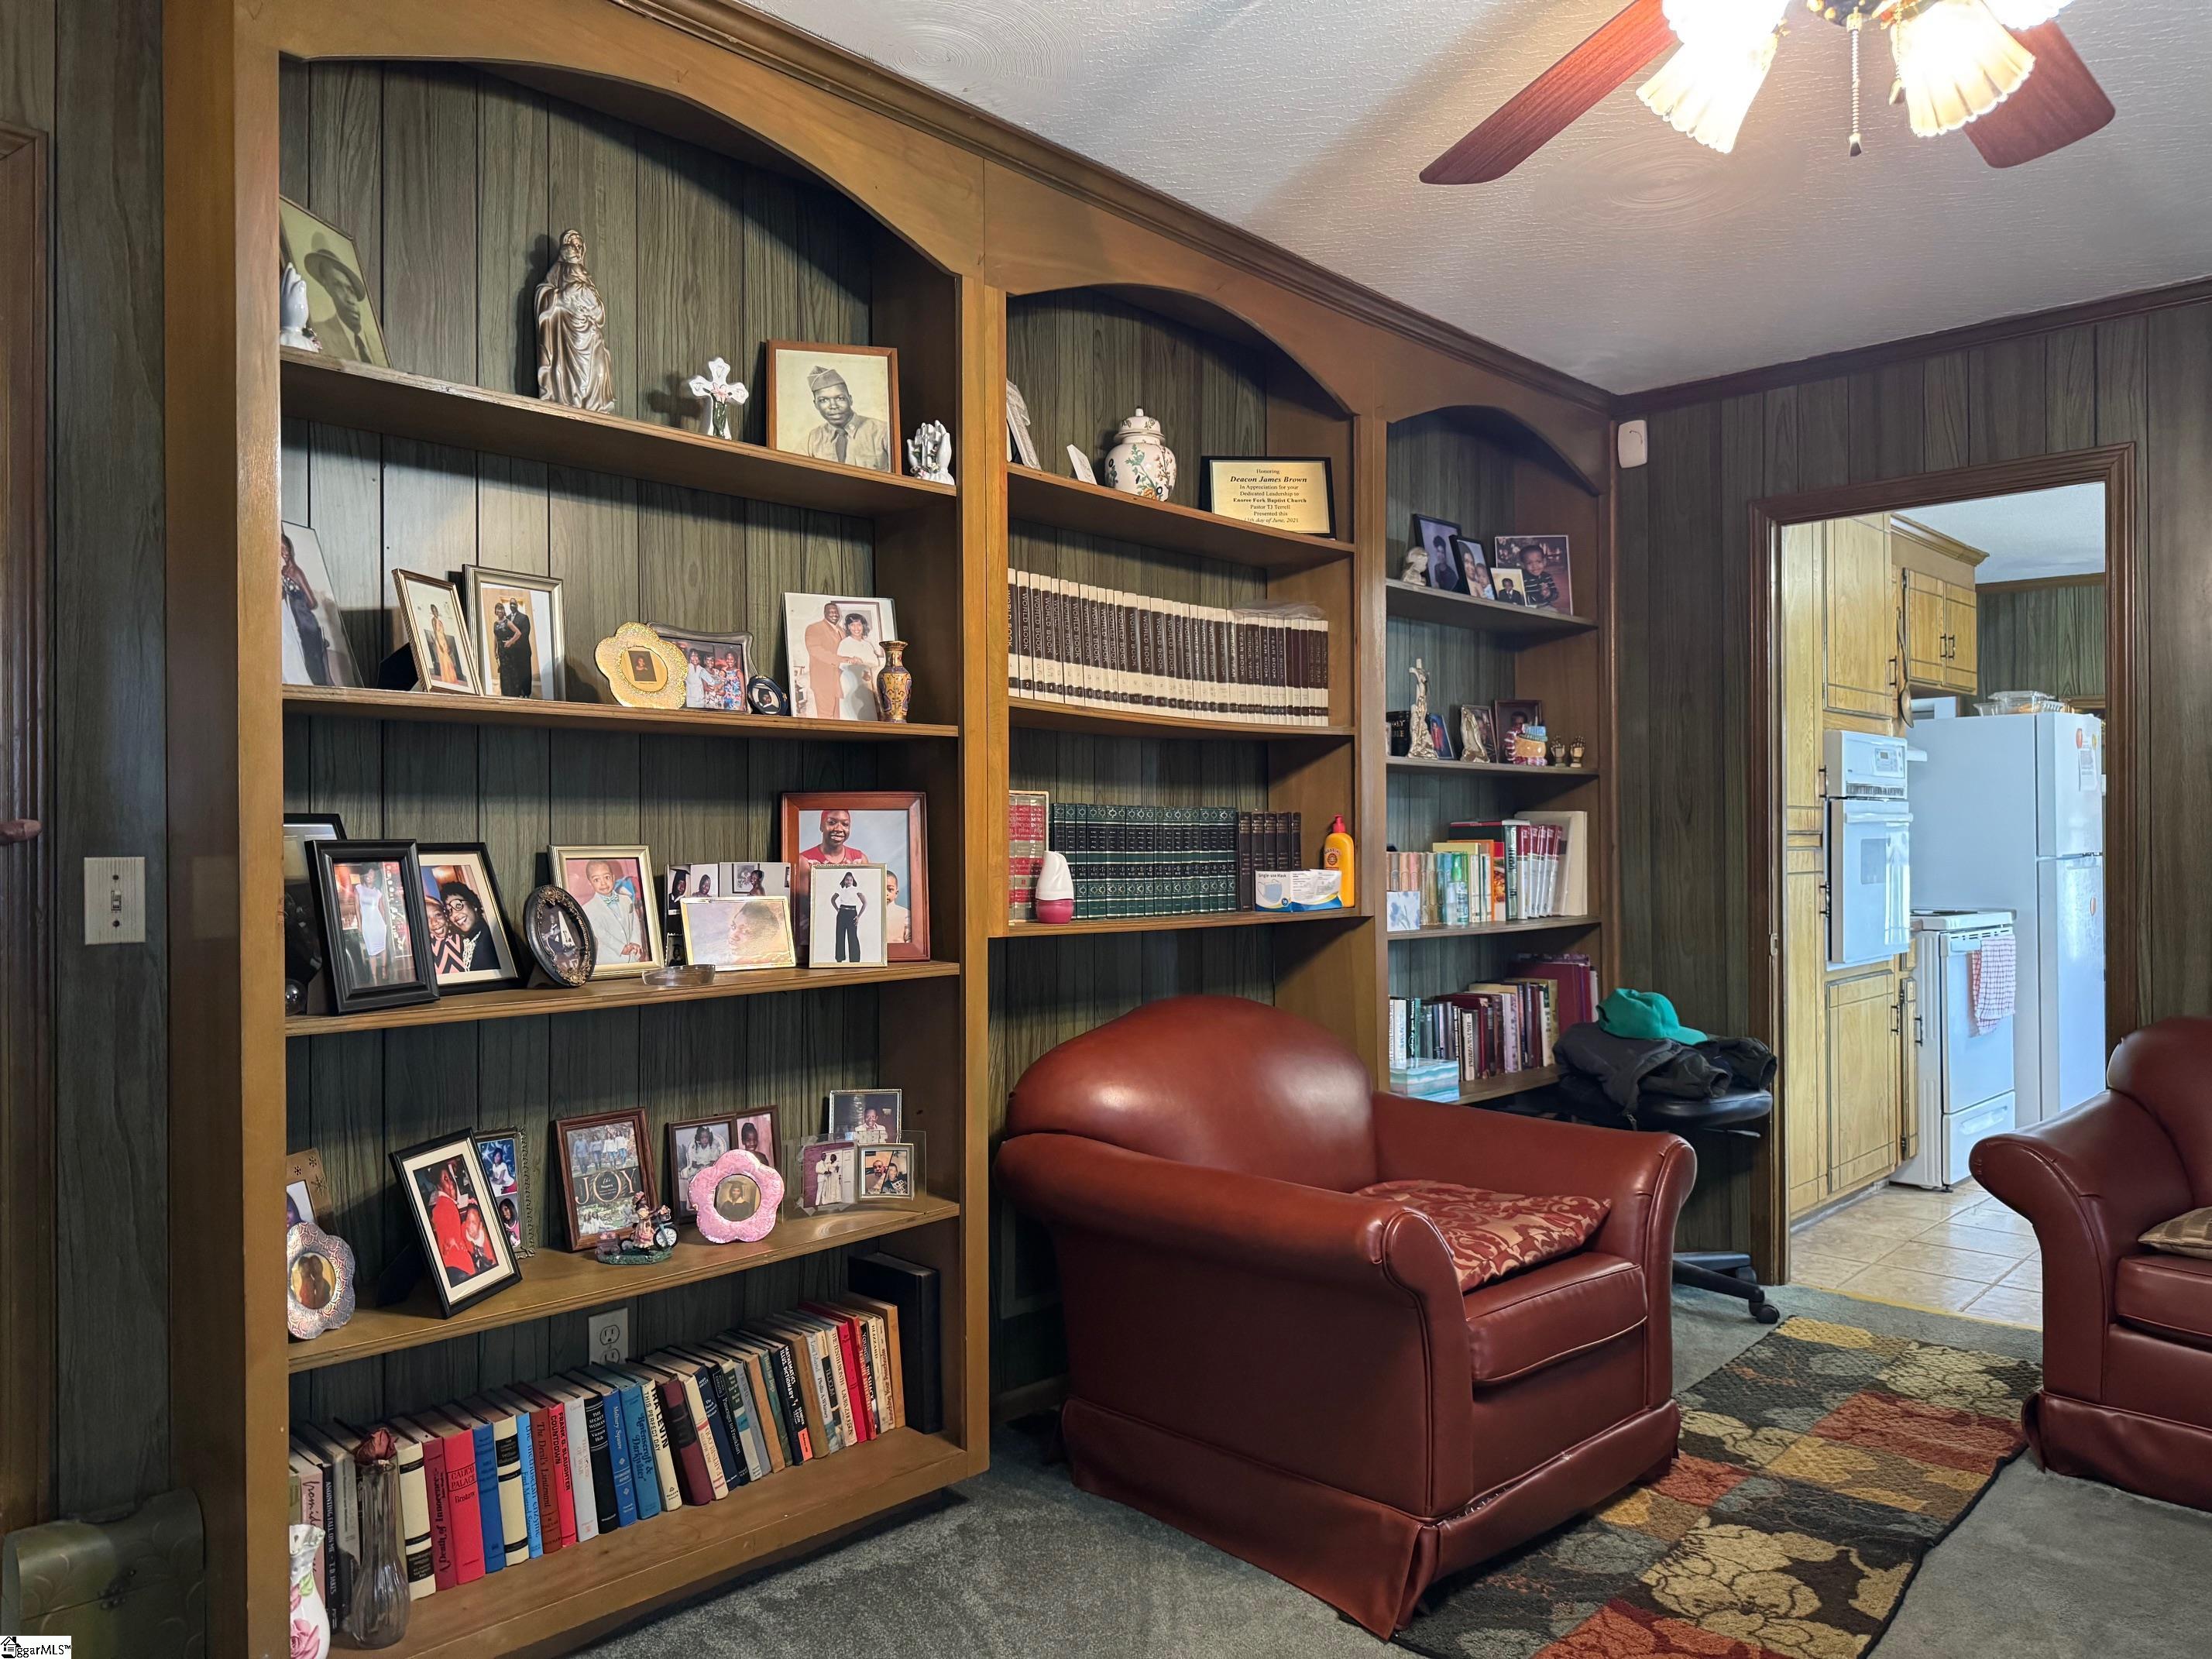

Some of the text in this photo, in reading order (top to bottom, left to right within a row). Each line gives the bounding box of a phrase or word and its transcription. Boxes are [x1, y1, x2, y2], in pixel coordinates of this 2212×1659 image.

[575, 1168, 637, 1204] JOY
[536, 1422, 545, 1437] The
[647, 1410, 658, 1437] PERFECT
[656, 1410, 668, 1449] LEVIN
[551, 1415, 561, 1465] COUNTDOWN
[730, 1429, 740, 1455] Frankfurt
[325, 1481, 335, 1516] ANOINTING
[455, 1492, 475, 1504] Bristow
